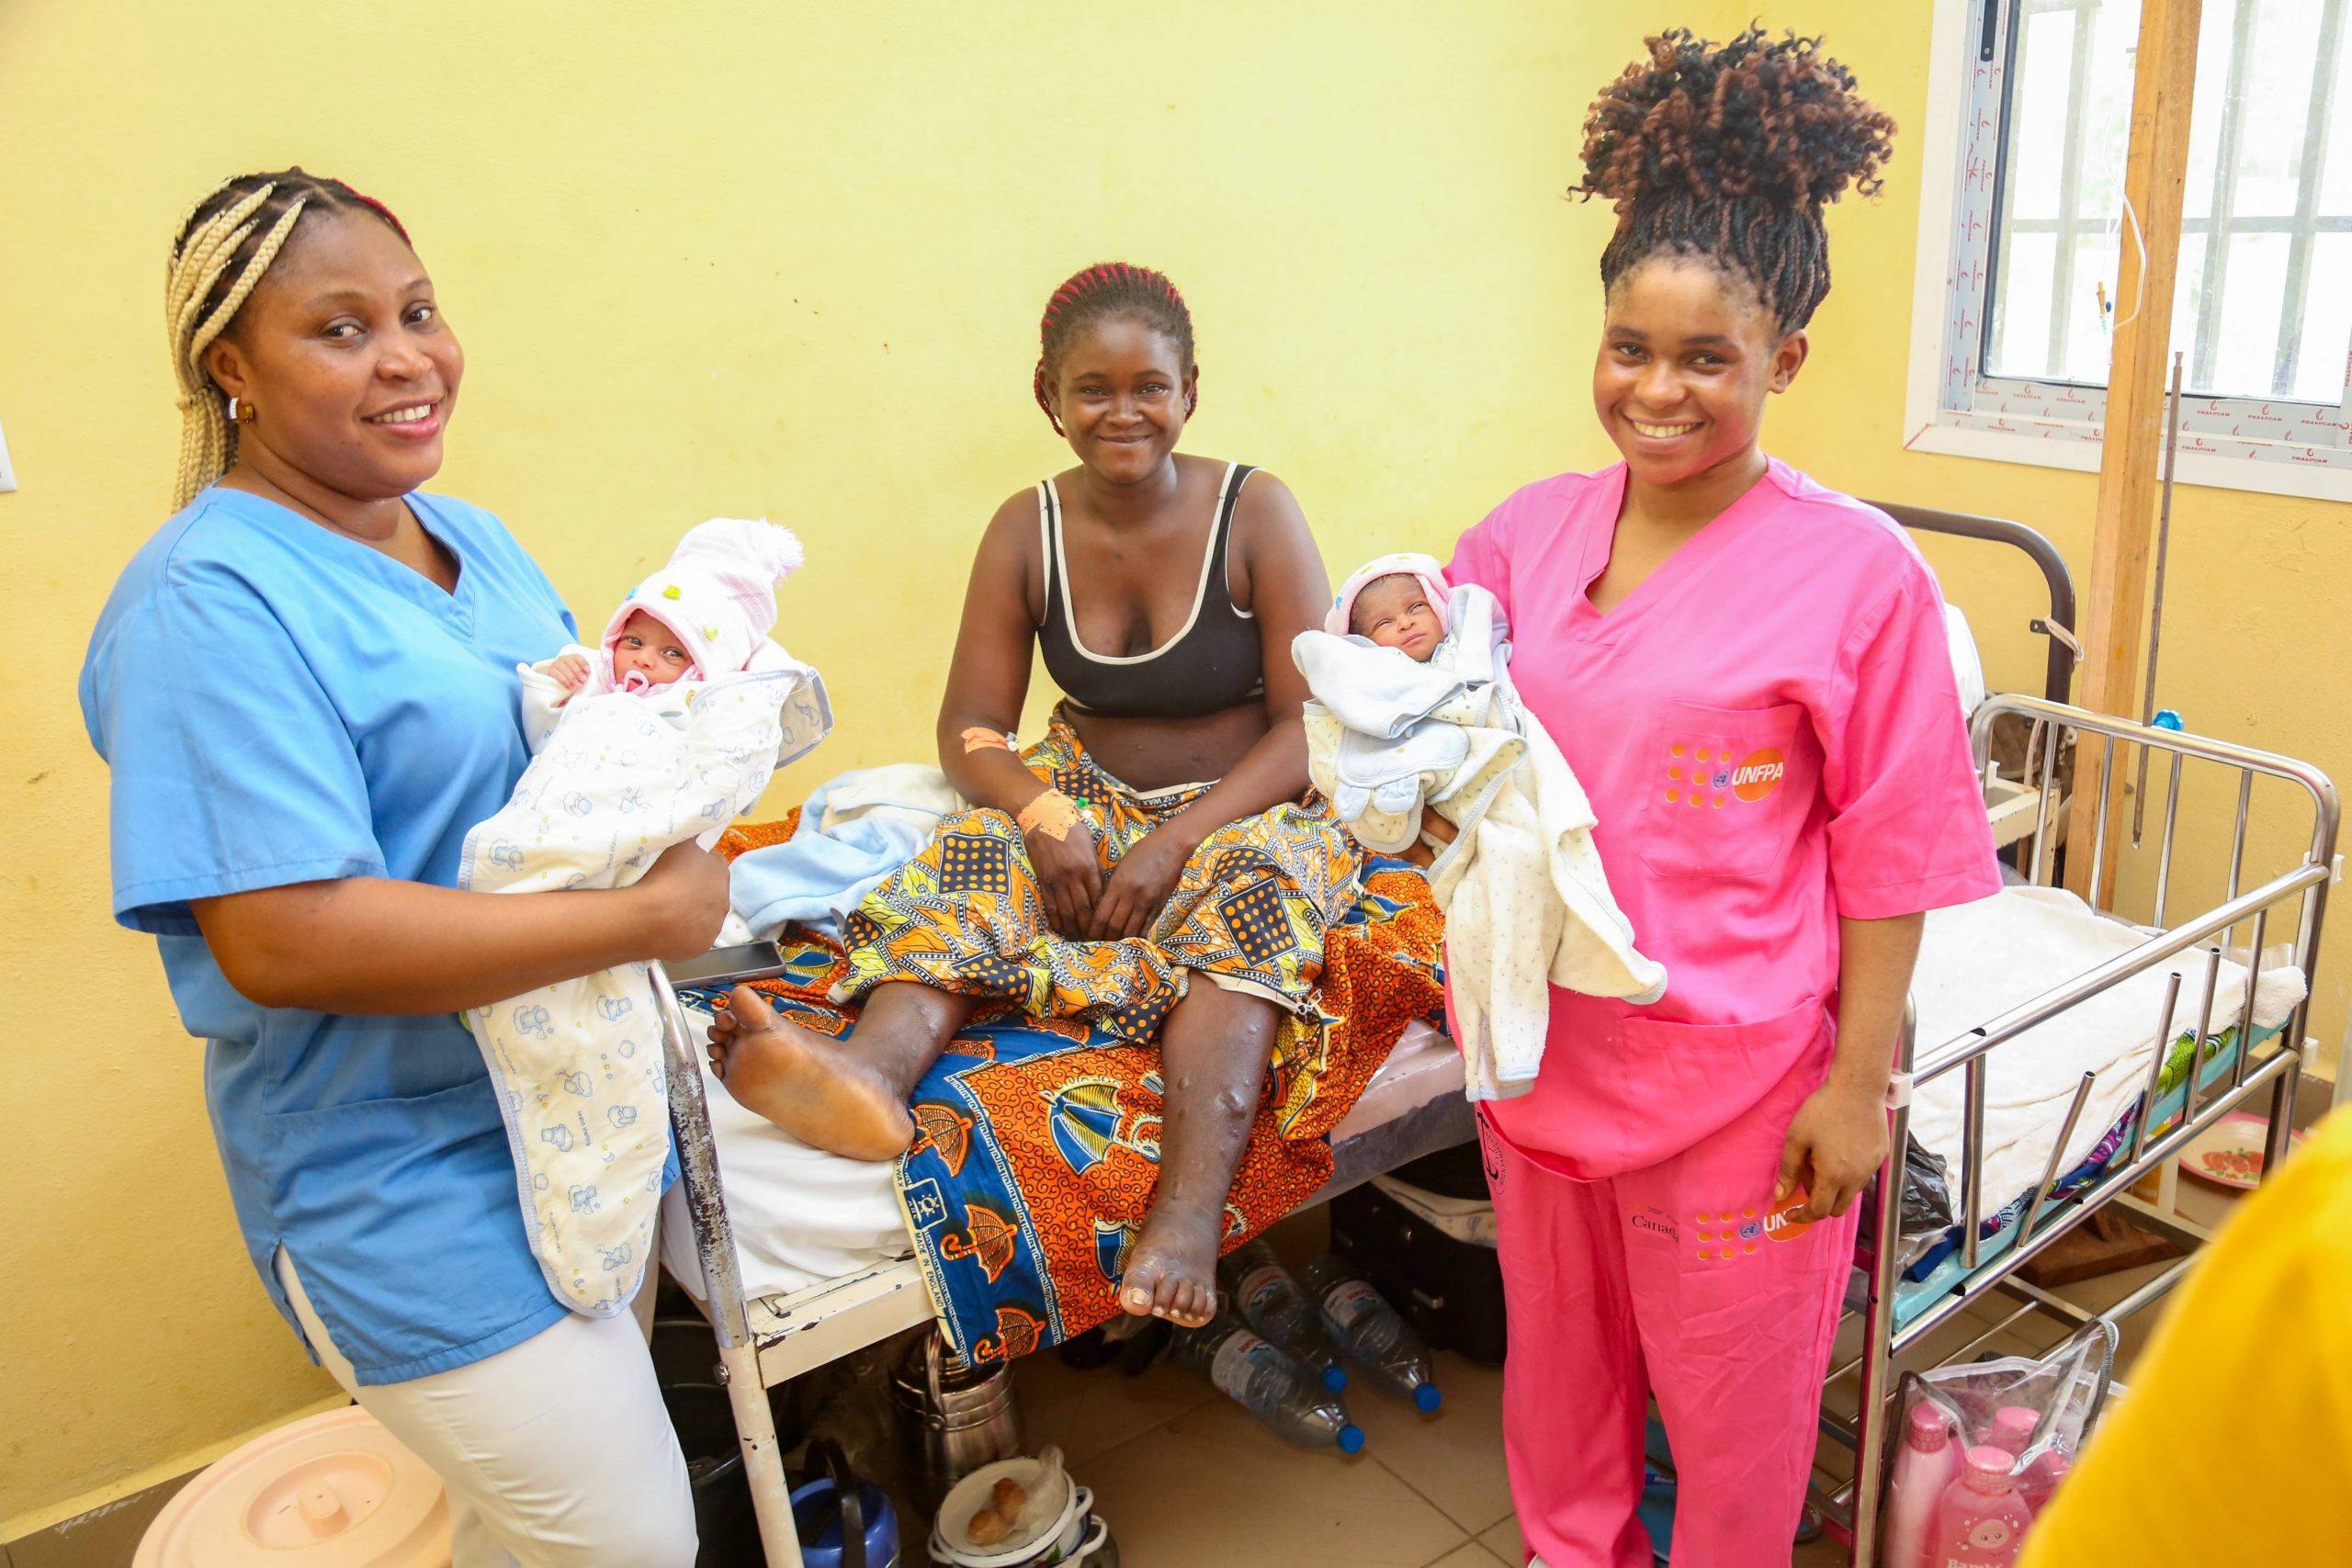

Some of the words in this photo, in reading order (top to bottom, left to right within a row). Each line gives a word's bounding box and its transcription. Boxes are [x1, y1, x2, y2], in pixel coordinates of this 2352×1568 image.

[1732, 761, 1784, 785] UNFPA
[896, 1168, 905, 1188] WAX
[914, 1232, 927, 1256] MADE
[922, 1258, 931, 1267] IN
[926, 1270, 944, 1308] ENGLAND
